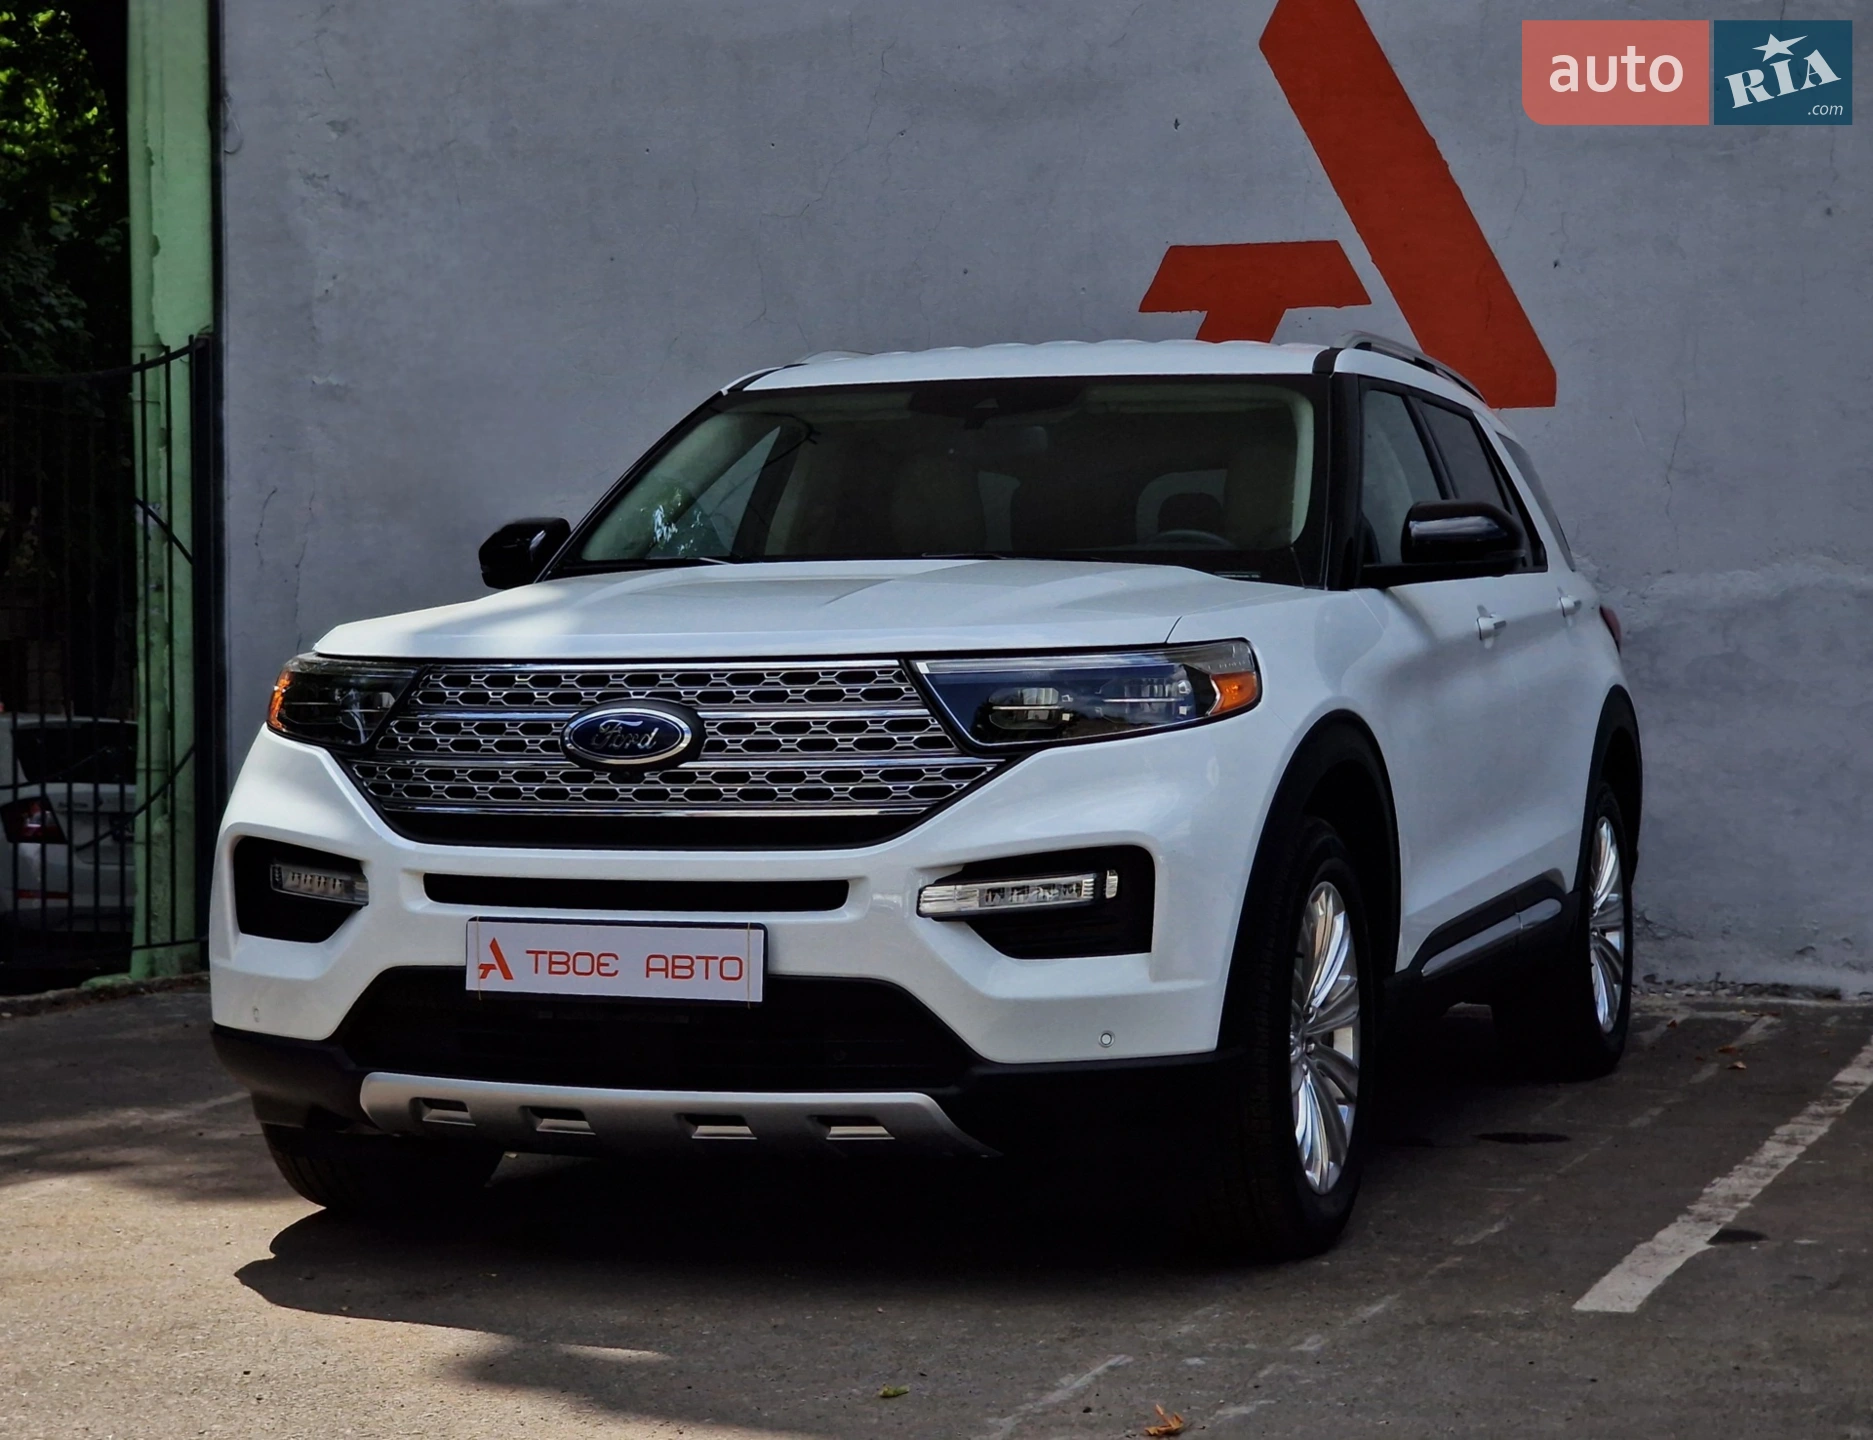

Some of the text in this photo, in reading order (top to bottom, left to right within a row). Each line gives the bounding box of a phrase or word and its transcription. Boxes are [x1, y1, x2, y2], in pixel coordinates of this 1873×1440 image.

[590, 719, 660, 749] Ford
[525, 949, 619, 977] ТВОЄ
[645, 954, 744, 981] АВТО
